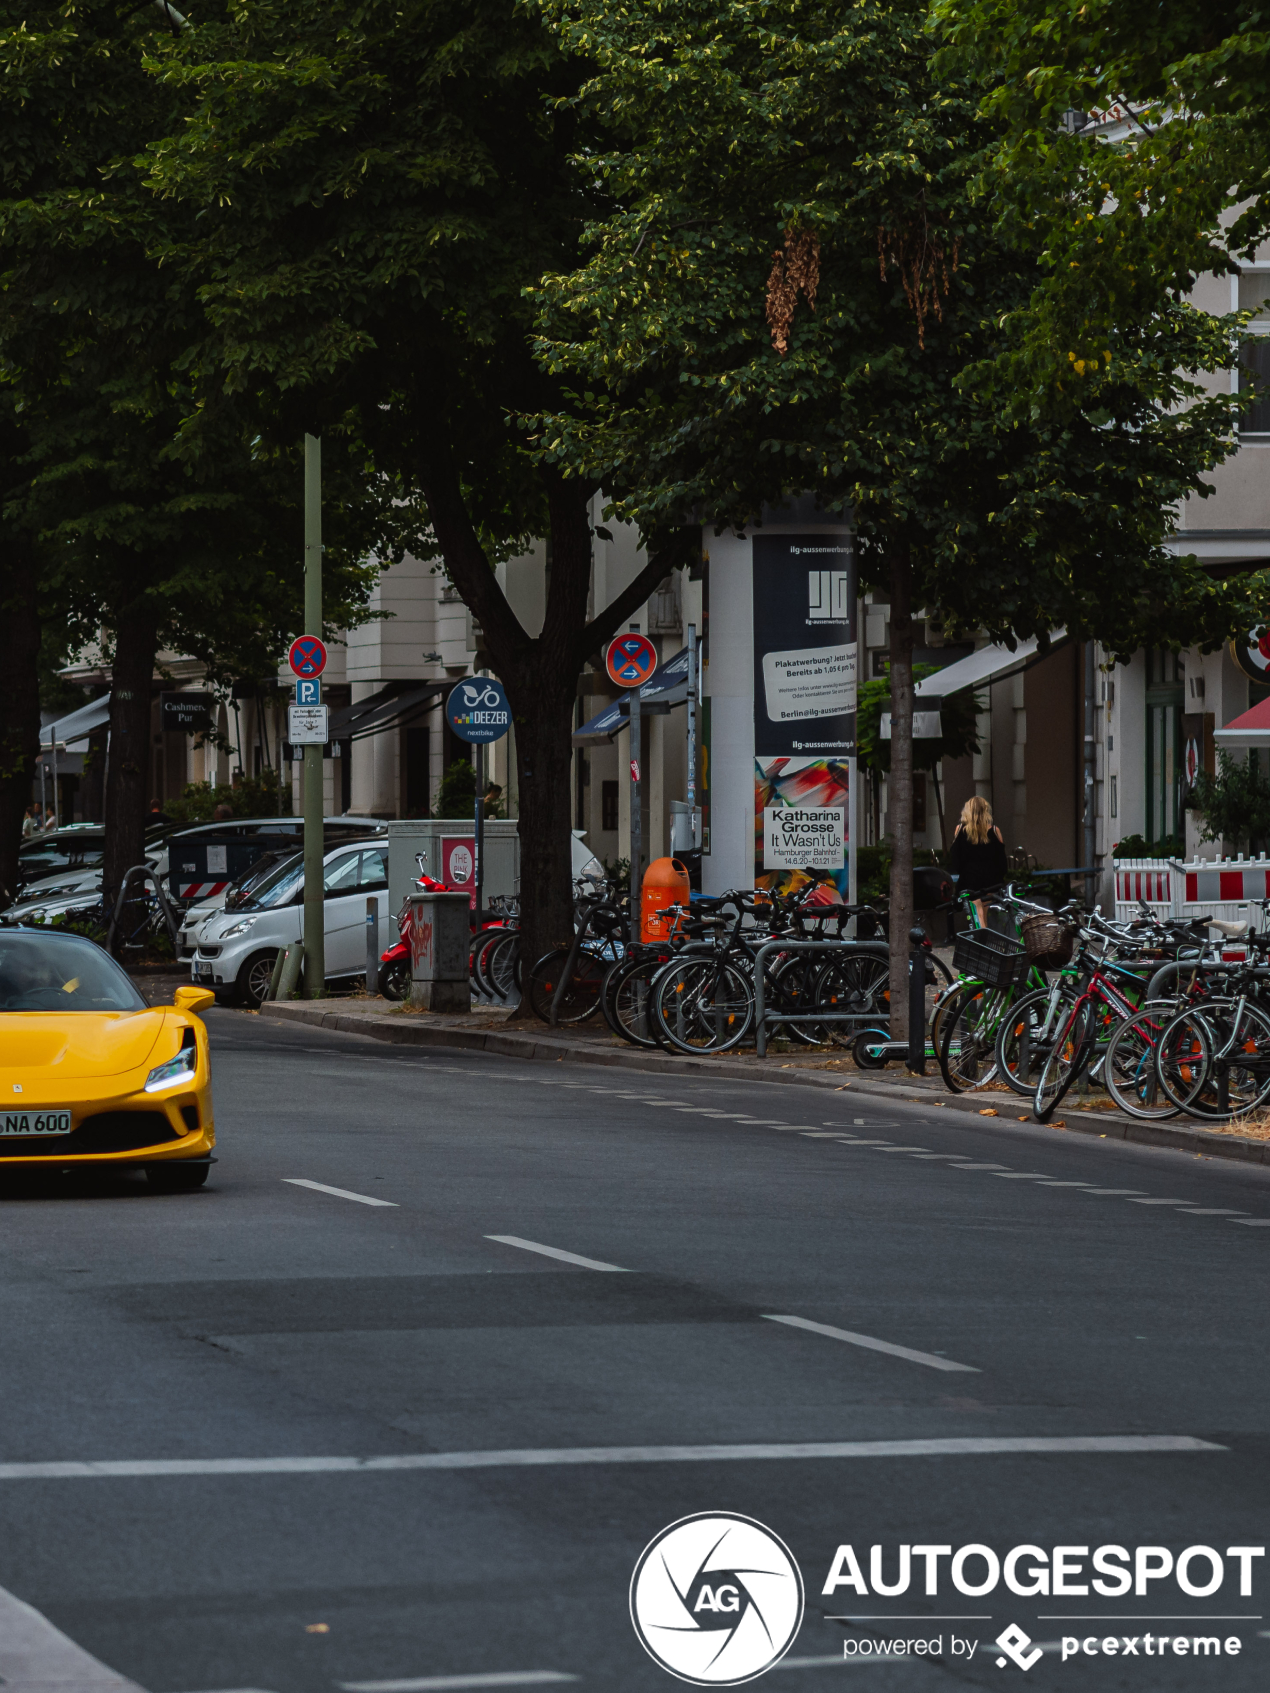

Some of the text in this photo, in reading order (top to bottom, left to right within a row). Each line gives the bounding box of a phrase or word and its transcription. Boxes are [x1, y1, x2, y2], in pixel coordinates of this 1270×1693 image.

[775, 656, 832, 668] Plakatwerbung?
[786, 668, 812, 678] Bereits
[824, 666, 836, 674] 1,05
[302, 682, 314, 702] P
[474, 711, 508, 724] DEEZER
[772, 810, 840, 821] Katharina
[782, 822, 834, 832] Grosse
[772, 834, 840, 846] It Wasn't Us
[454, 854, 468, 864] THE
[774, 848, 812, 858] Hamburger
[6, 1116, 30, 1132] NA
[34, 1114, 69, 1132] 600
